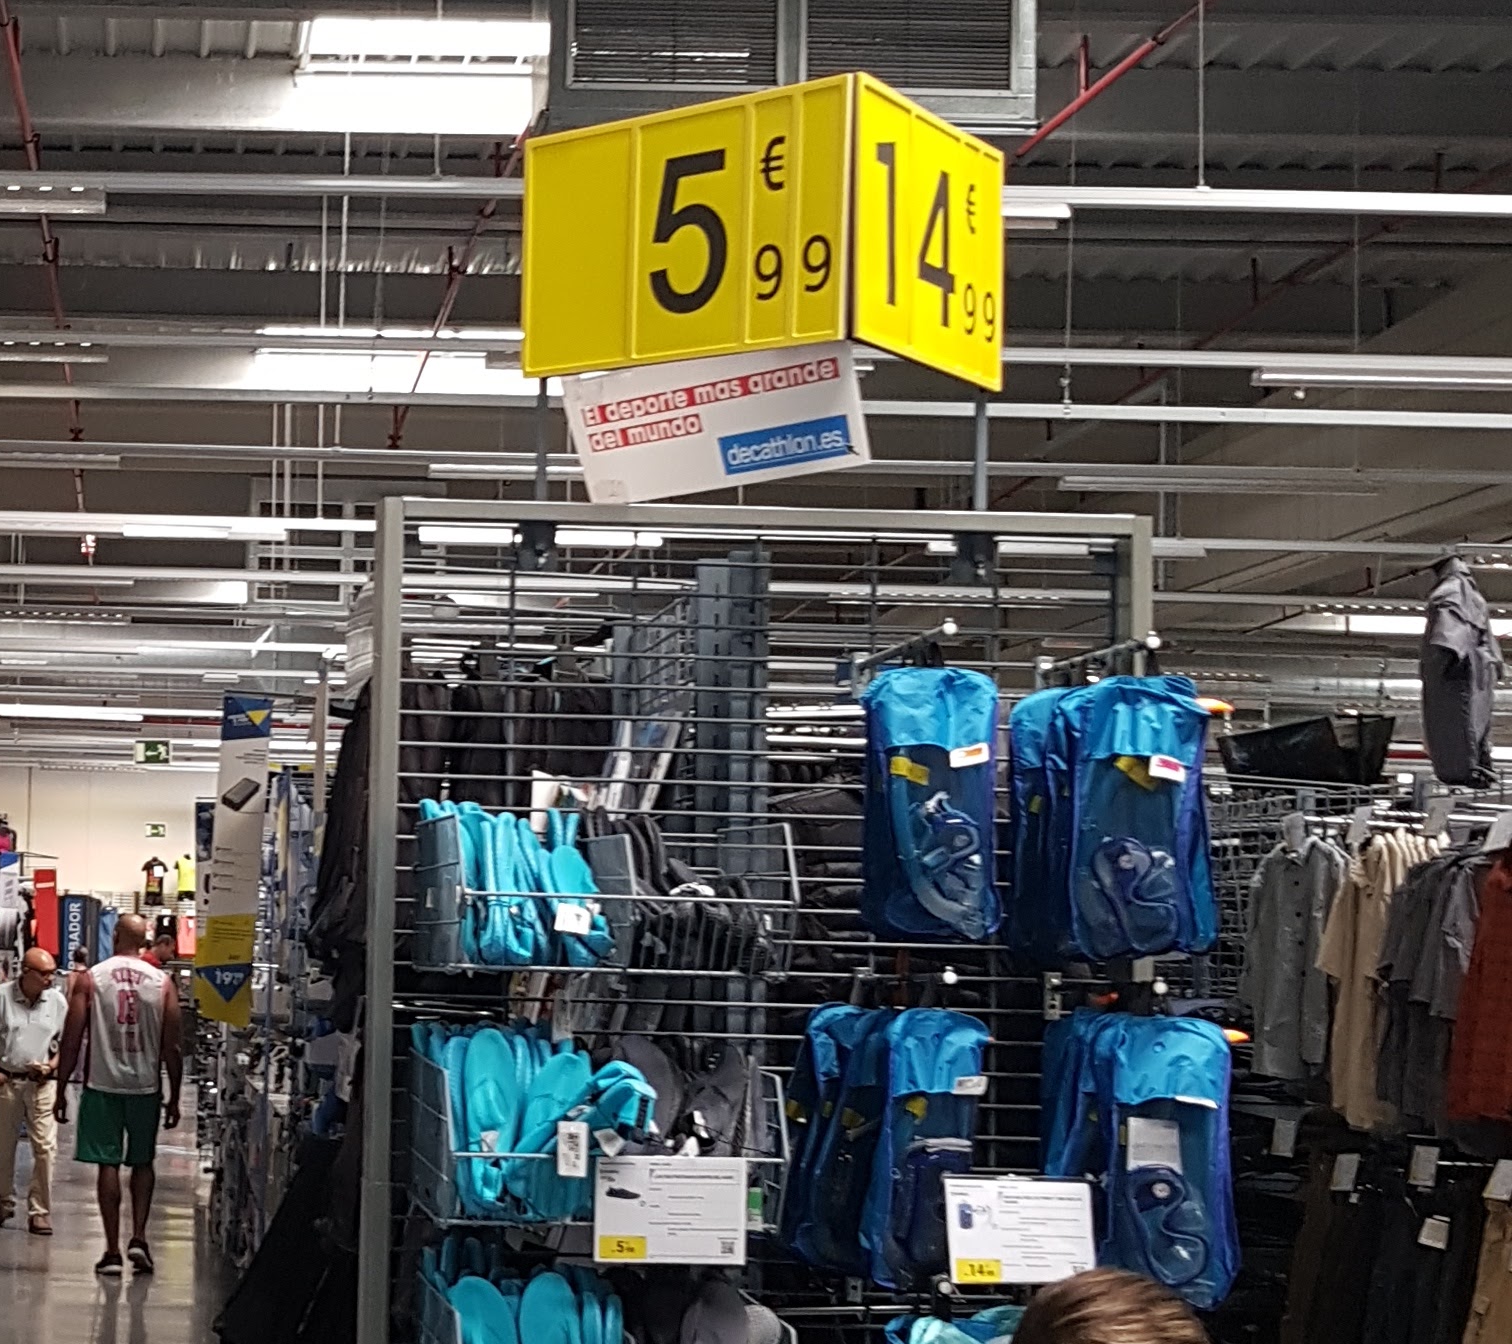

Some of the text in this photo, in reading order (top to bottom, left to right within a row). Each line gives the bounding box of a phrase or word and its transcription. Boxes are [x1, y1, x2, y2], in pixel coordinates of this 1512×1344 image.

[585, 357, 835, 426] El deporte mas grande
[590, 413, 701, 452] del mundo
[726, 427, 846, 466] decathlon.es
